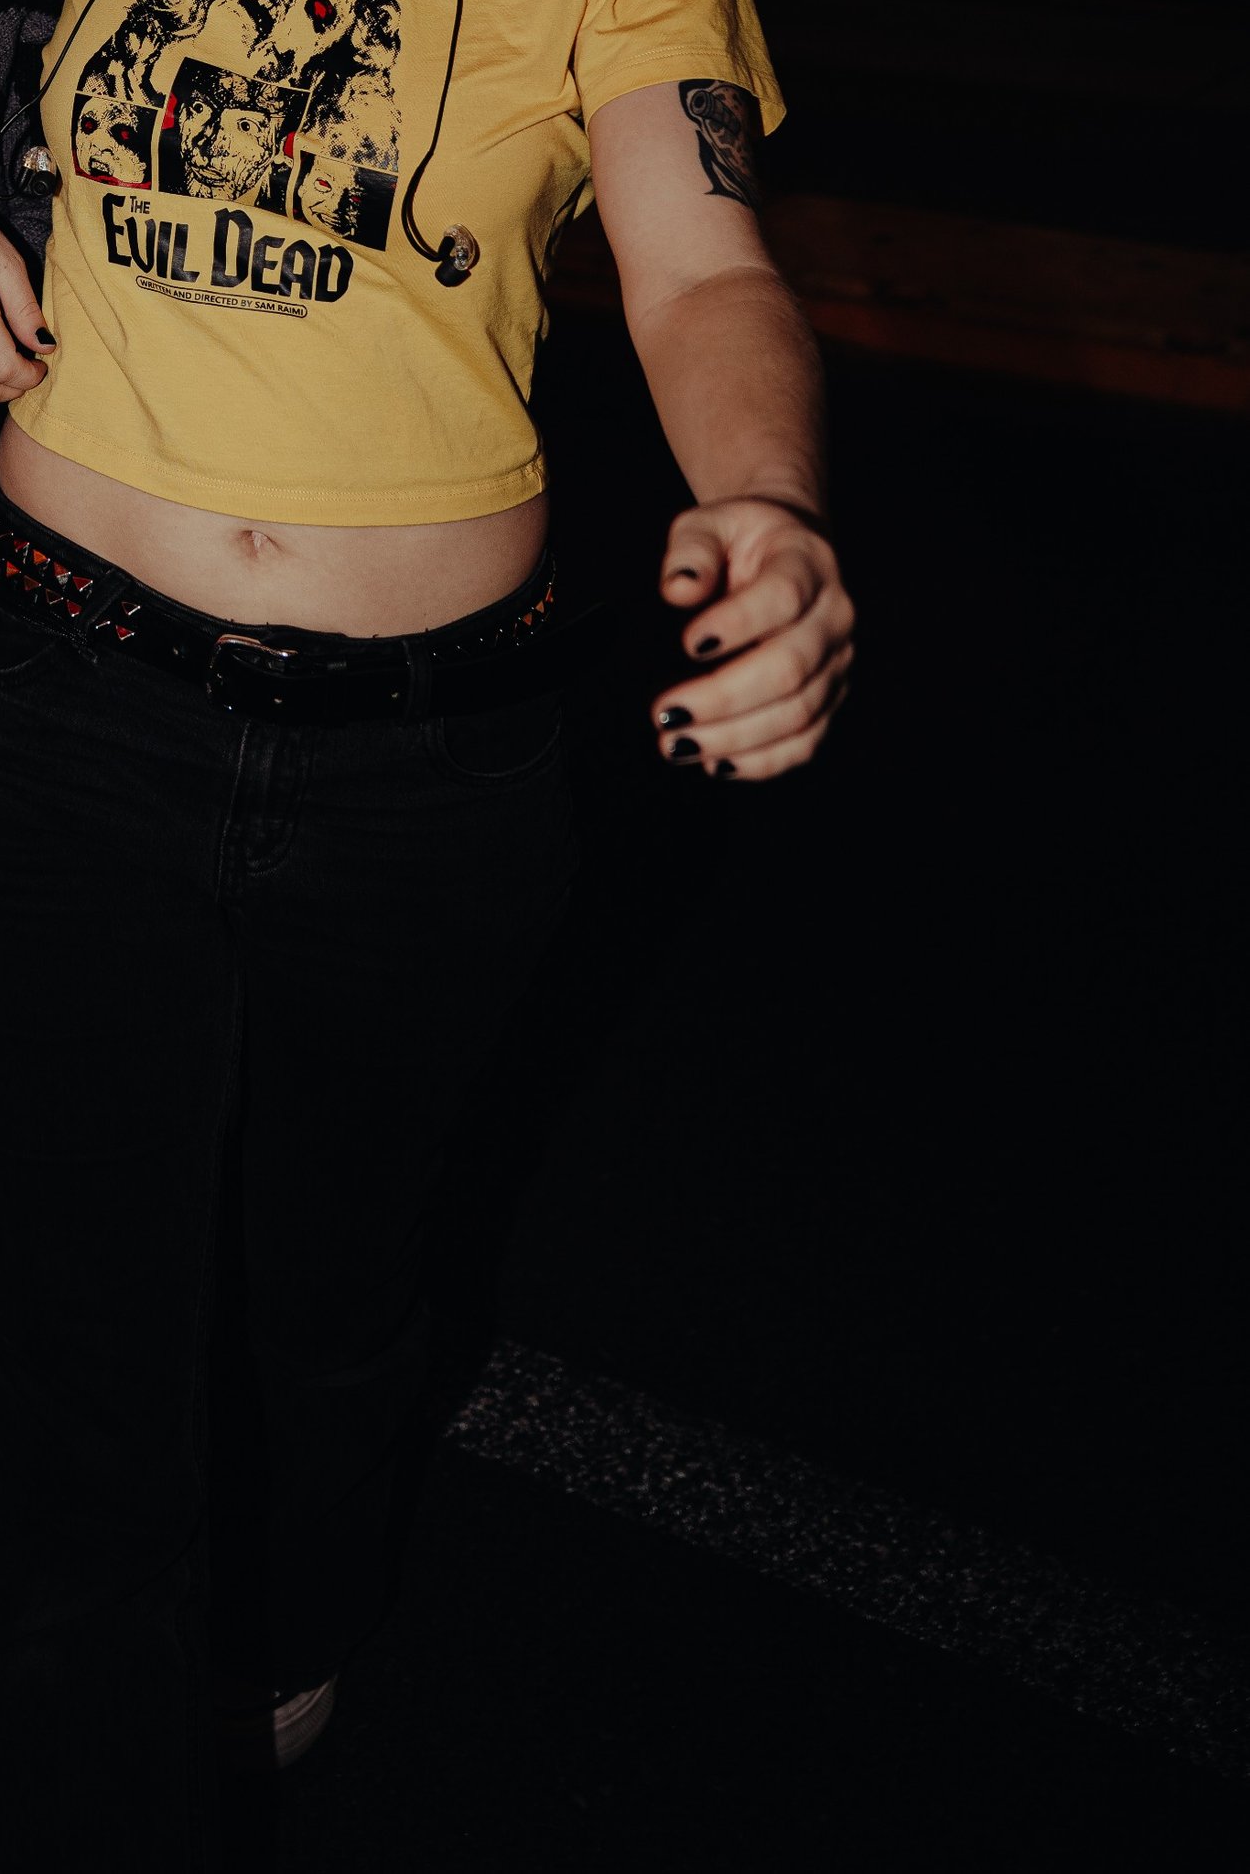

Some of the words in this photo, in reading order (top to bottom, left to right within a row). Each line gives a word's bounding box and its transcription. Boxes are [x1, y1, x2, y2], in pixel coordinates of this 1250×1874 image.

[211, 208, 354, 303] DEAD
[139, 278, 172, 295] WRITTEN
[173, 290, 192, 300] AND
[194, 293, 239, 306] DIRECTED
[241, 300, 253, 308] BY
[254, 301, 276, 311] SAM
[277, 305, 304, 316] RAIMI
